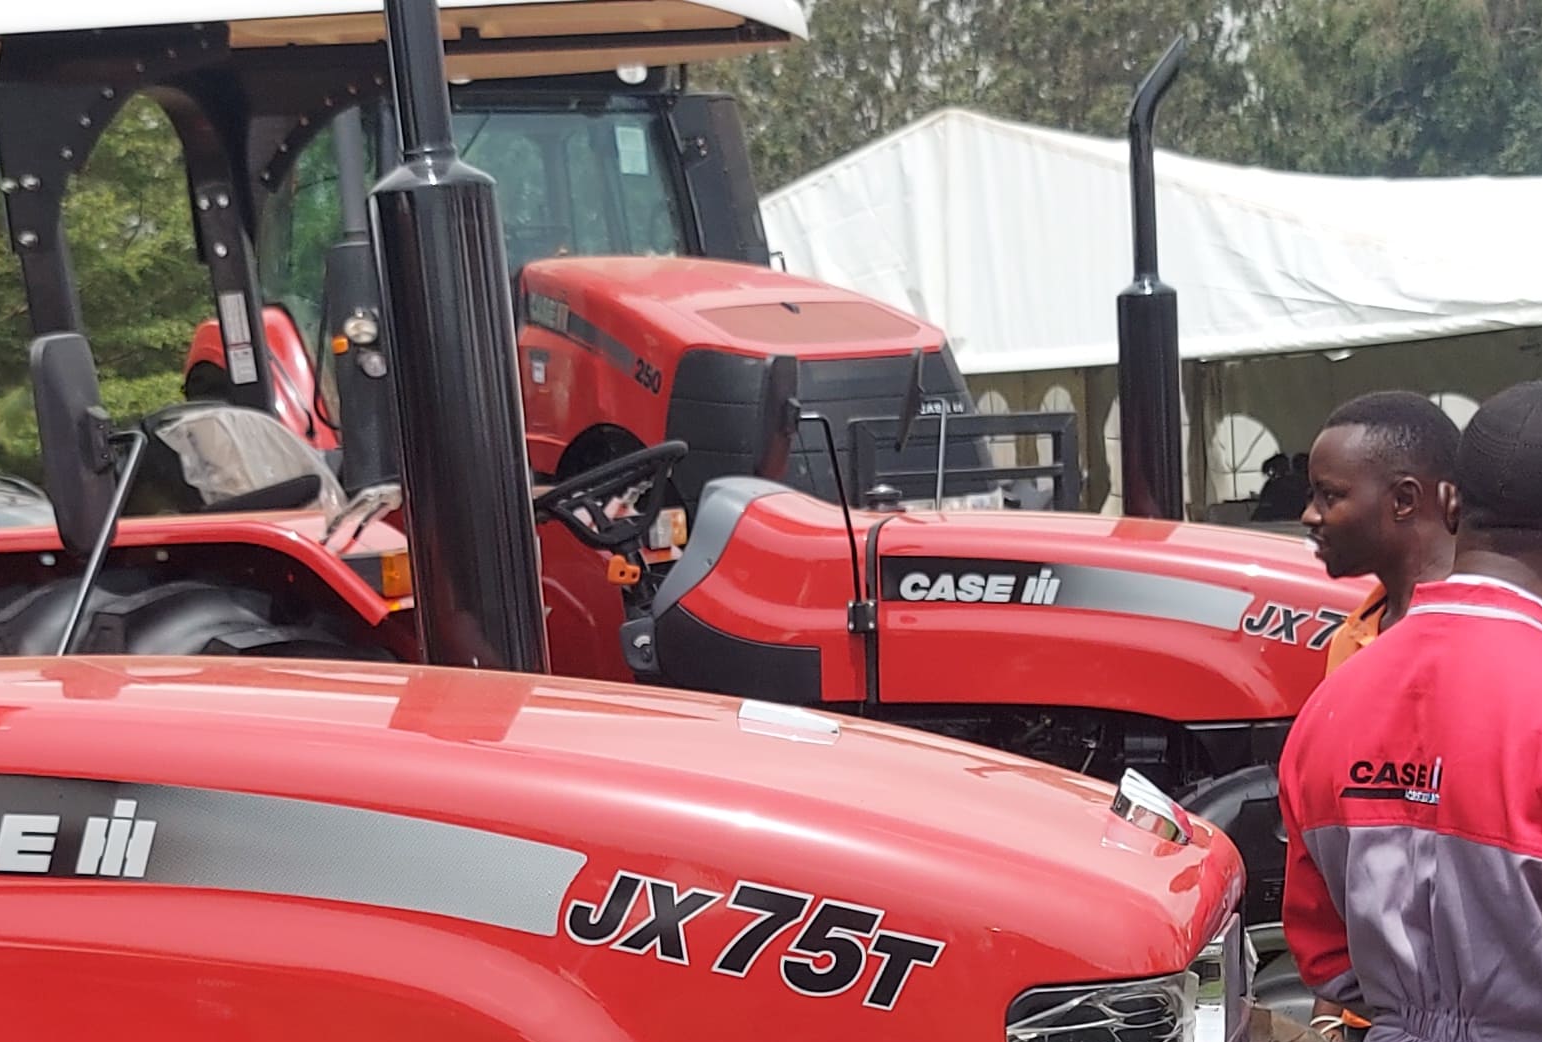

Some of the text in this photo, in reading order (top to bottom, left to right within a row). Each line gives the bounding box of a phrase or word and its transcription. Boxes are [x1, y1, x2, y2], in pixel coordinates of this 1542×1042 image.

[634, 357, 662, 396] 250
[899, 573, 1015, 604] CASE
[1349, 761, 1428, 788] CASE
